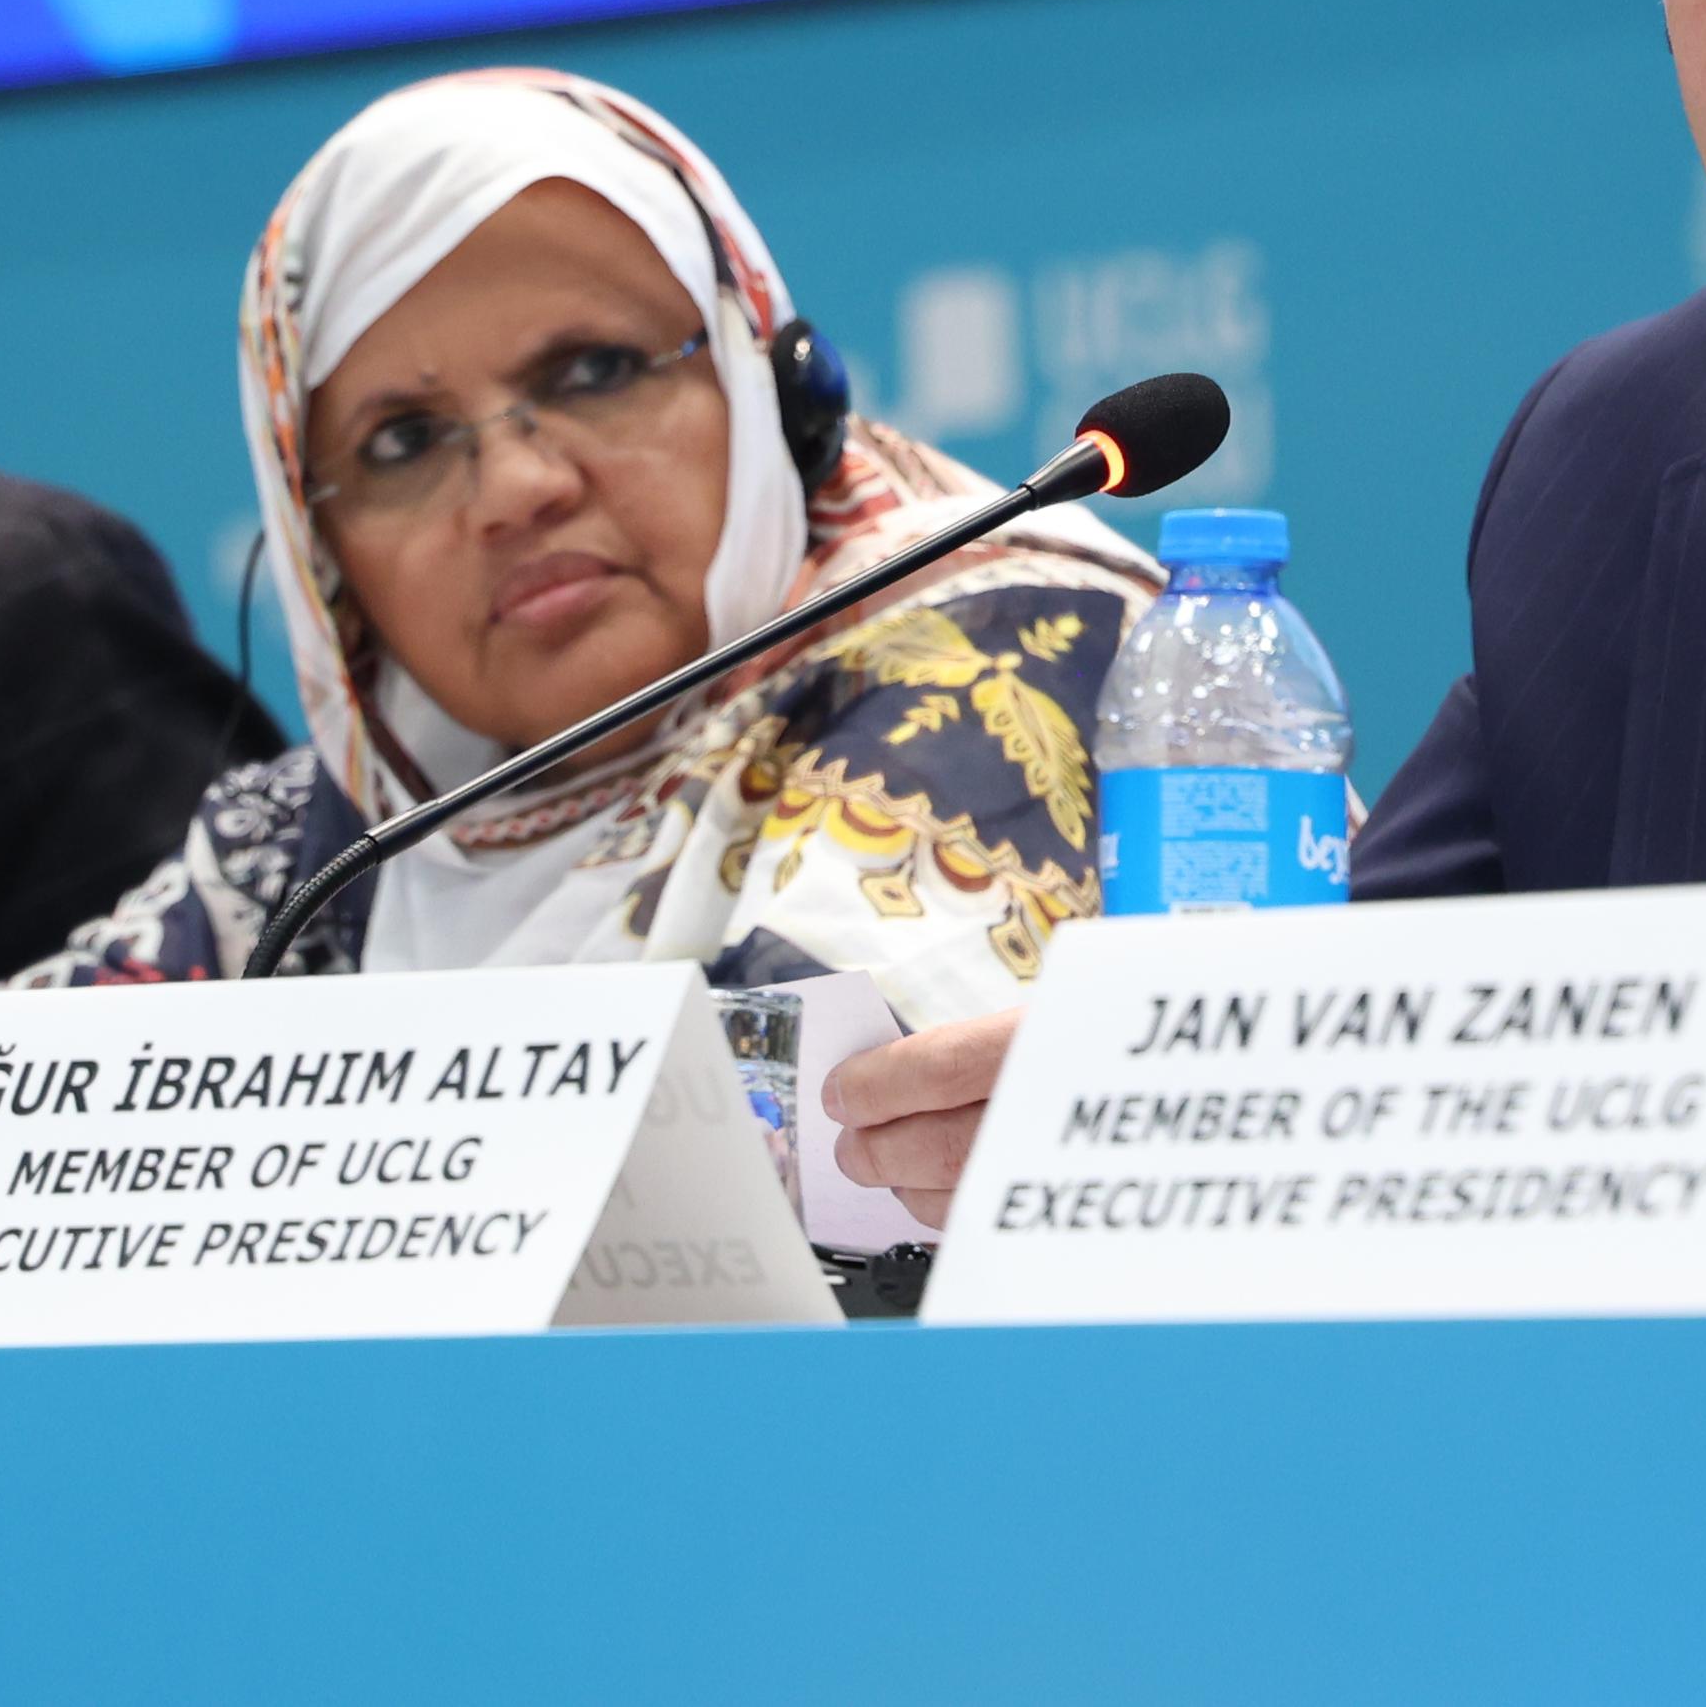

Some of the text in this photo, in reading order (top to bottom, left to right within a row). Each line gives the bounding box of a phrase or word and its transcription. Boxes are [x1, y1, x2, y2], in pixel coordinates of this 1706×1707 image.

[1127, 977, 1697, 1058] JAN VAN ZANEN
[112, 1041, 416, 1113] İBRAHIM
[427, 1038, 649, 1101] ALTAY
[1060, 1074, 1706, 1145] MEMBER OF THE UCLG
[6, 1137, 483, 1196] MEMBER OF UCLG
[994, 1175, 1317, 1233] EXECUTIVE
[194, 1211, 549, 1267] PRESIDENCY
